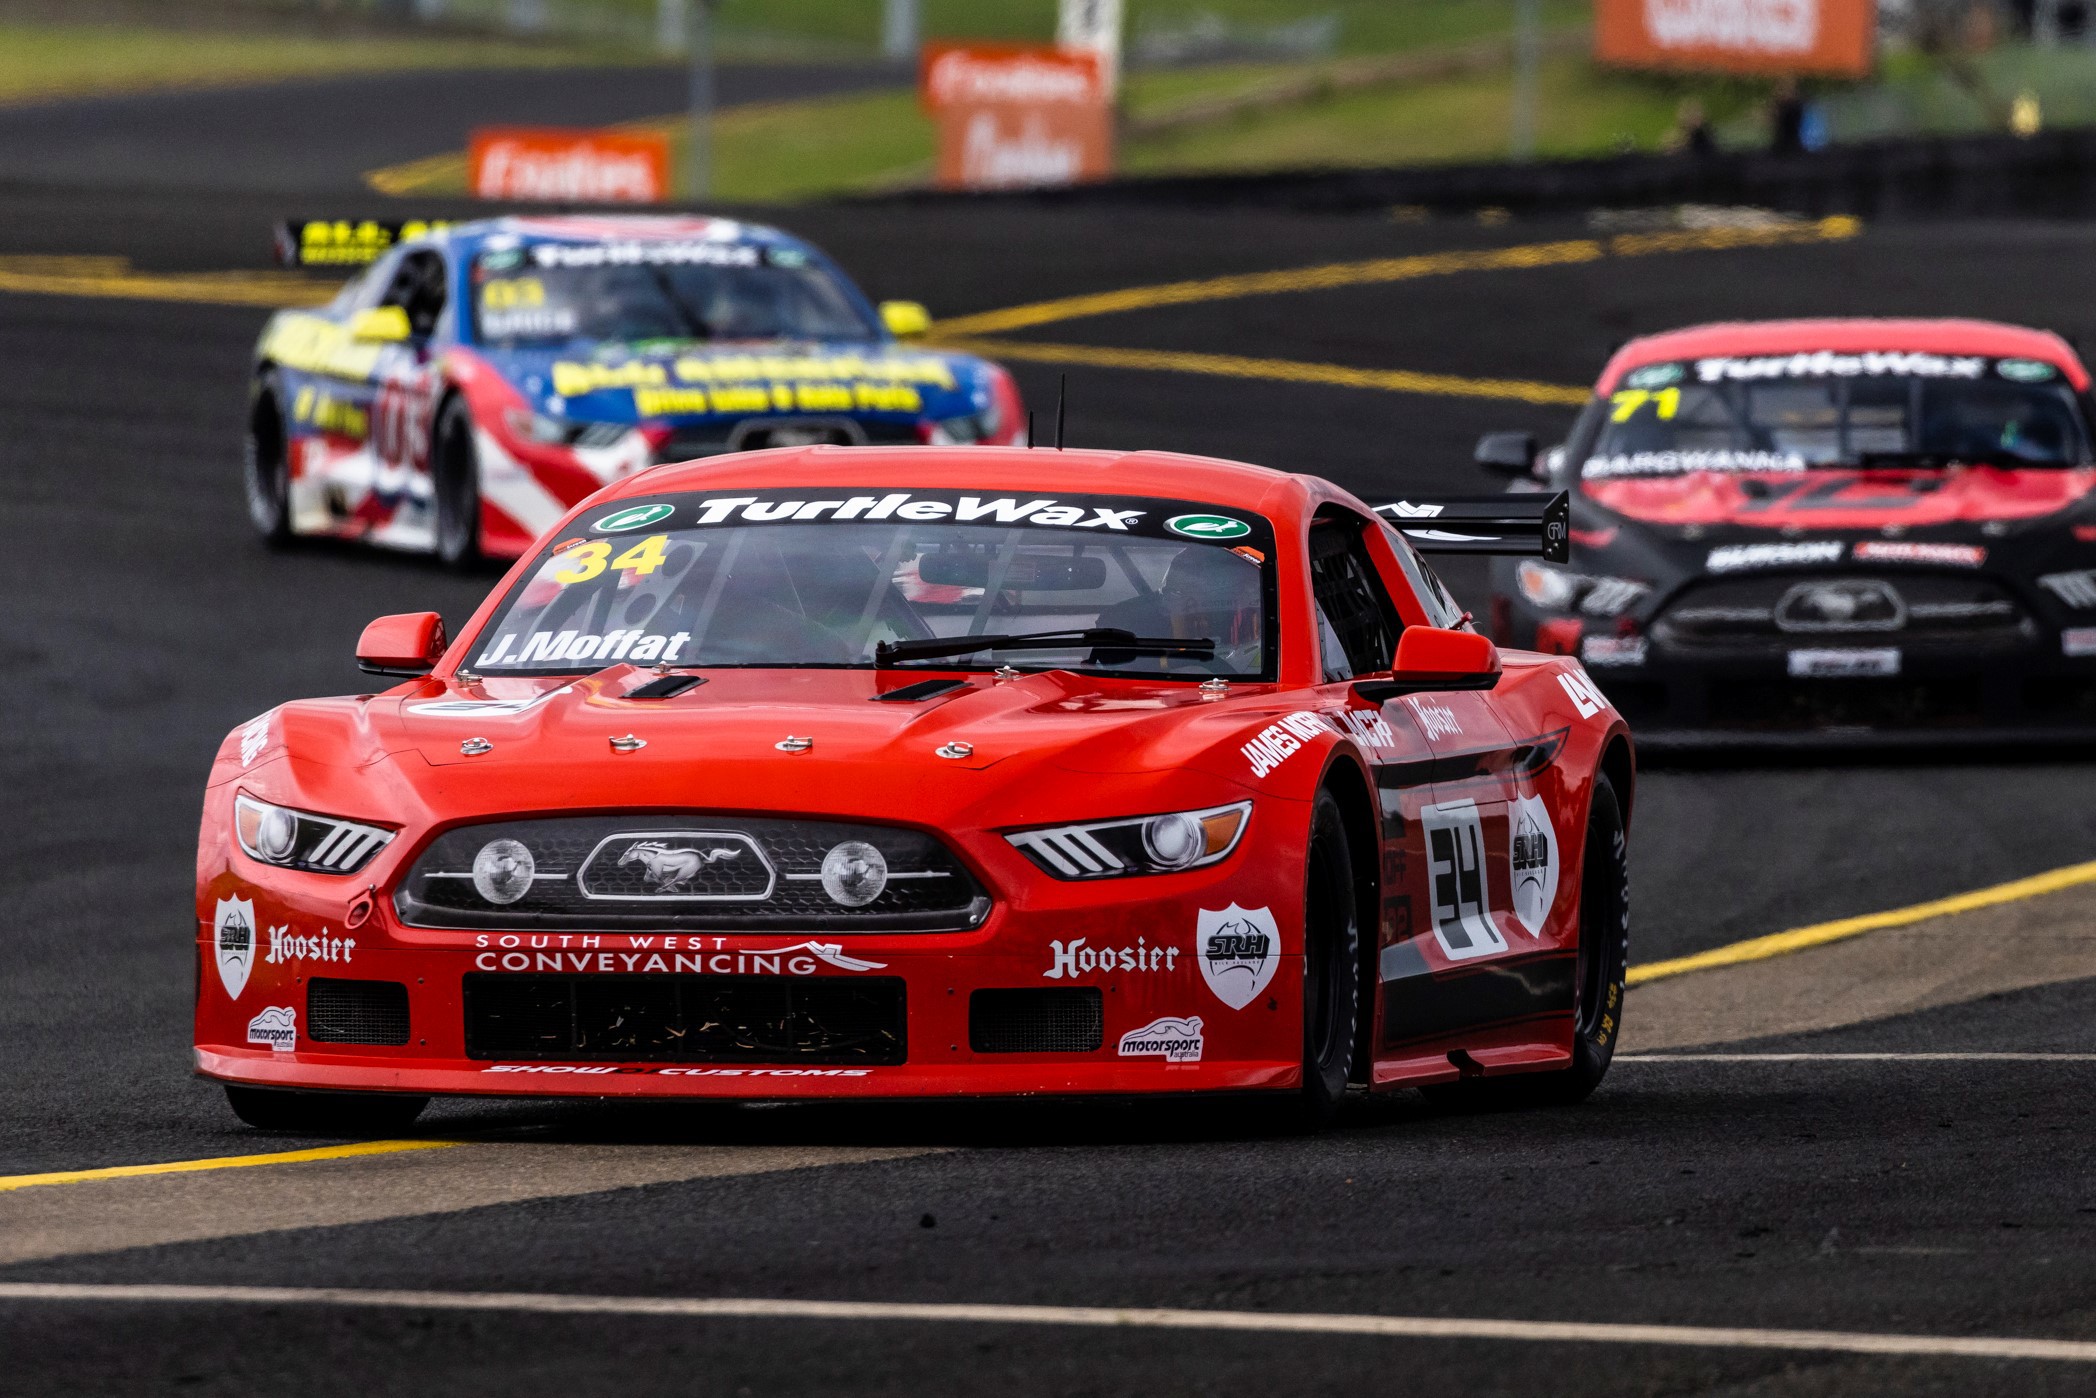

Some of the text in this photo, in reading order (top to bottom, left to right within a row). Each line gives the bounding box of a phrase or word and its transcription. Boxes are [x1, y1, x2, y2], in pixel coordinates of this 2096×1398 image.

[1695, 350, 1987, 383] TurtleWax
[1611, 386, 1680, 424] 71
[555, 534, 668, 584] 34
[473, 629, 691, 668] J.Moffat
[1239, 725, 1302, 779] JAMES
[1430, 824, 1500, 950] 34
[265, 924, 356, 965] Hoosier
[475, 934, 727, 950] SOUTH WEST
[1042, 935, 1180, 979] Hoosier
[1206, 934, 1270, 960] SRH
[475, 951, 817, 976] CONVEYANCING
[249, 1027, 294, 1047] motorsport
[1121, 1038, 1201, 1057] motorsport
[481, 1064, 618, 1075] SHOW
[659, 1068, 873, 1077] CUSTOMS
